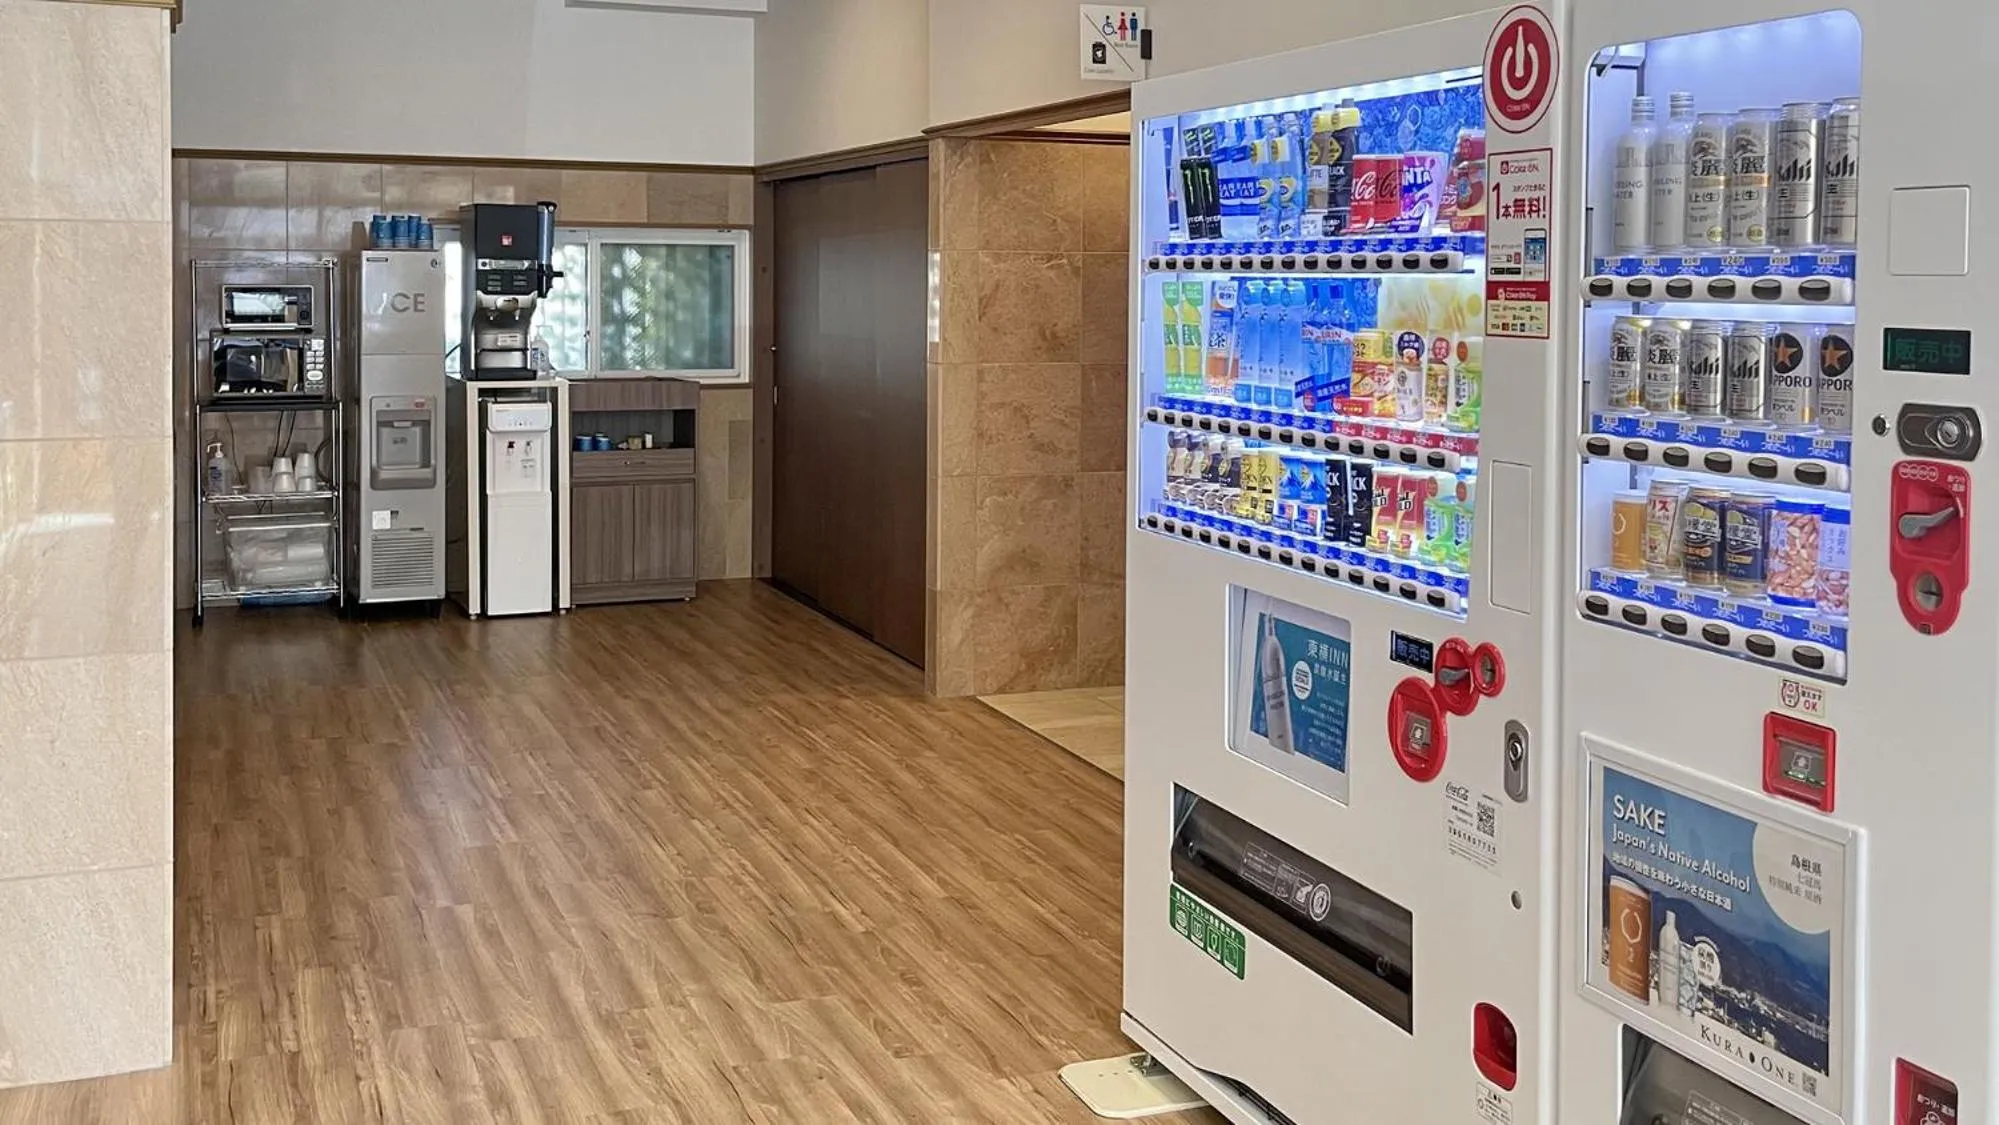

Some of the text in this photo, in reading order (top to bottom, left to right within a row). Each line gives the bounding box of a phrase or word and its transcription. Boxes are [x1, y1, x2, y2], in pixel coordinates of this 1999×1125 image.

[1777, 158, 1812, 182] sahi
[1773, 375, 1812, 388] PPORO
[1307, 640, 1349, 668] 東横INN
[1396, 638, 1431, 664] 販売中
[1613, 794, 1667, 835] SAKE
[1612, 824, 1751, 893] Japan's Native Alcohol
[1700, 1023, 1796, 1084] KURA ONE
